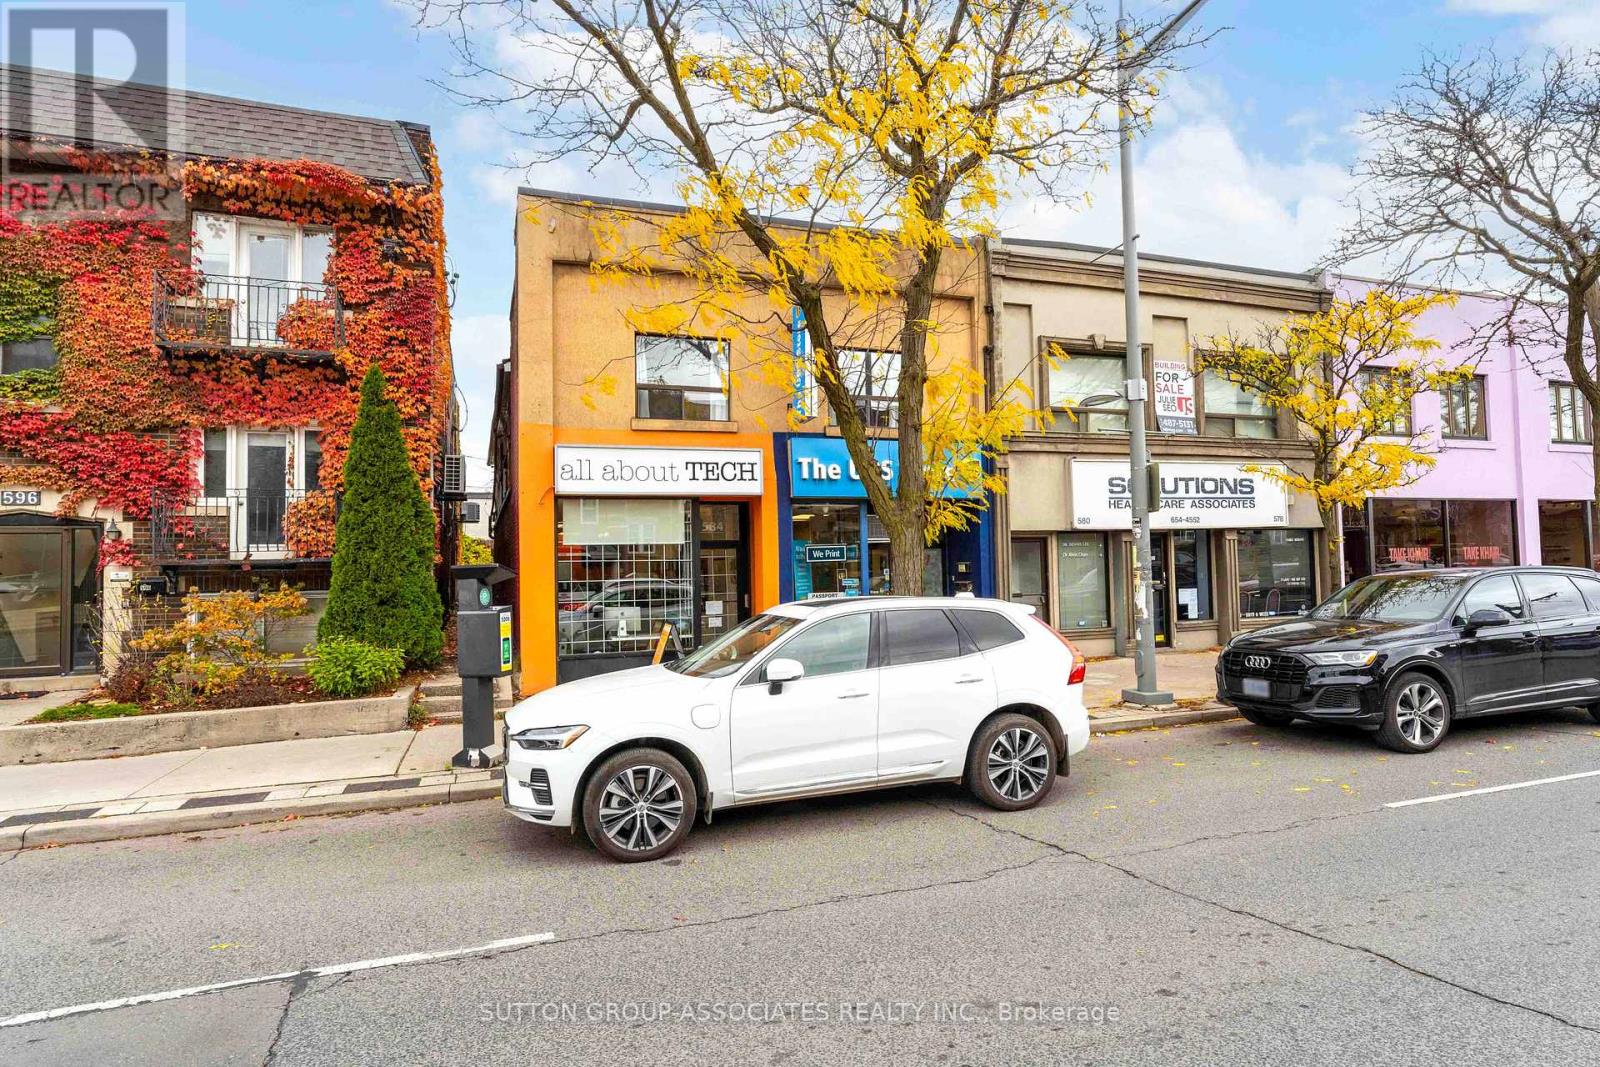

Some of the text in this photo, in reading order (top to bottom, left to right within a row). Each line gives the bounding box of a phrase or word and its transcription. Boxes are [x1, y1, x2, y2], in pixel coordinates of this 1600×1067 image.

[1154, 361, 1186, 370] BUILDING
[1155, 371, 1179, 383] FOR
[1155, 383, 1185, 395] SALE
[1158, 396, 1176, 404] JULIE
[1163, 404, 1177, 412] SEO
[560, 459, 758, 482] all about TECH
[797, 457, 842, 481] The
[849, 458, 894, 481] US
[1108, 476, 1255, 494] SUTIONS
[3, 491, 38, 505] 596
[1190, 500, 1256, 509] ASSOCIATES
[702, 521, 724, 532] 584
[1077, 517, 1091, 525] 580
[812, 550, 824, 558] We
[825, 549, 840, 558] Print
